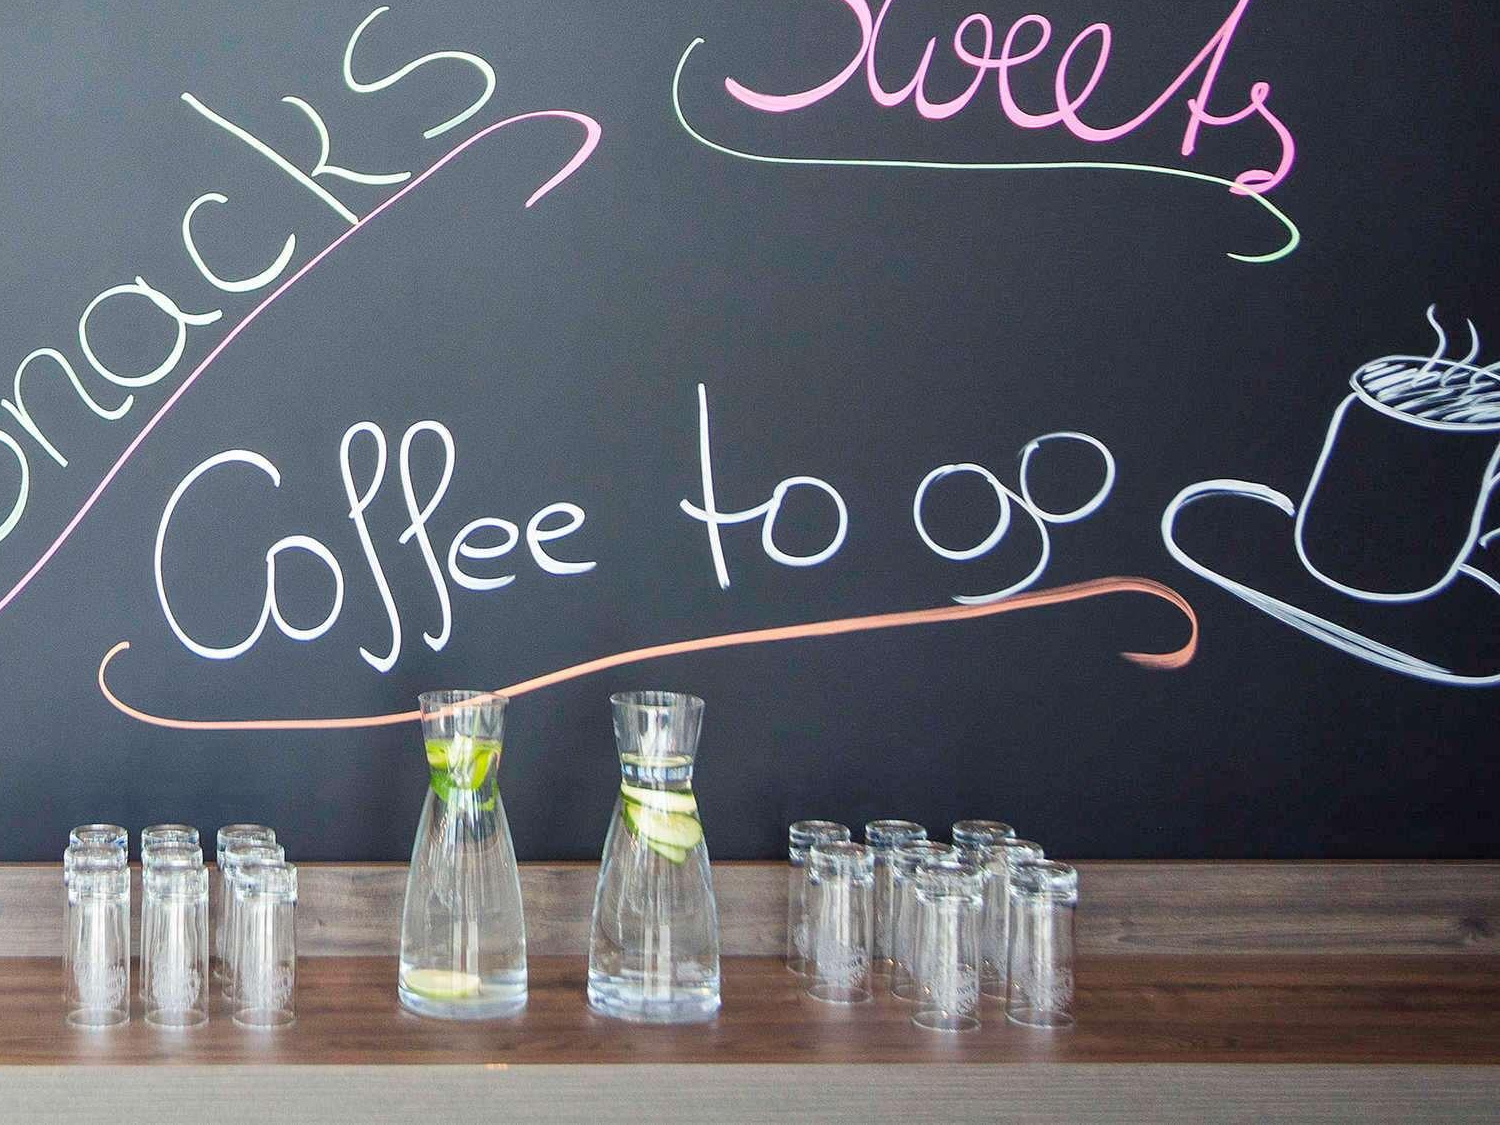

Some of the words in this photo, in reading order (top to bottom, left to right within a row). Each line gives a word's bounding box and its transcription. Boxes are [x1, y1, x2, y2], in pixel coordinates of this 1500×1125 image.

[152, 420, 597, 674] Coffee
[680, 382, 849, 589] to
[912, 431, 1117, 606] go
